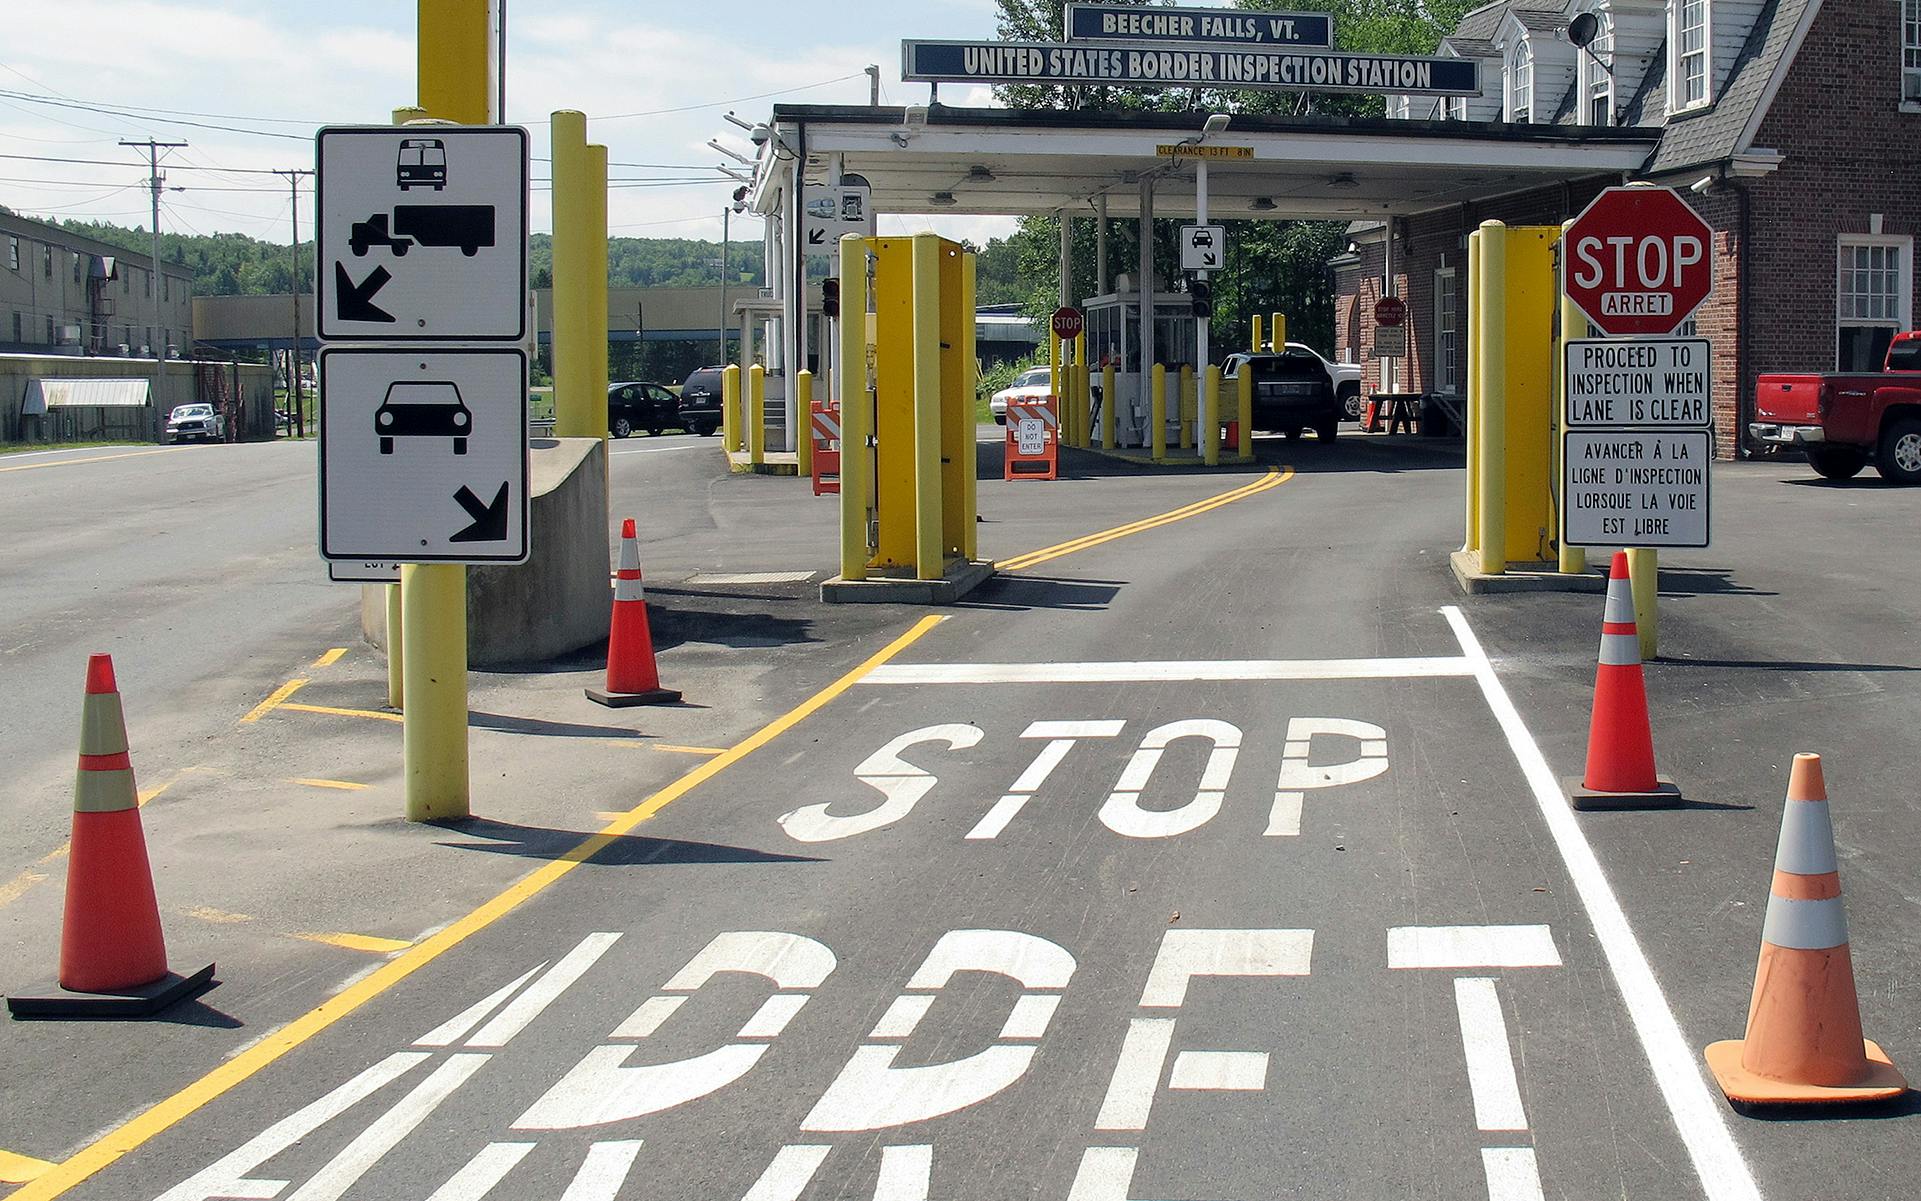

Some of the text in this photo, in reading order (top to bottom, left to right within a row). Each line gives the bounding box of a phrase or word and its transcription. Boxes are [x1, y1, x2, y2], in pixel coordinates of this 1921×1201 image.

[1102, 13, 1300, 42] BEECHER FALLS, VT.
[963, 47, 1431, 88] UNITED STATES BORDER INSPECTION STATION
[1159, 145, 1204, 156] CLEARANCE
[1210, 146, 1218, 156] 13
[1220, 147, 1229, 156] FT
[1574, 235, 1703, 289] STOP
[1606, 294, 1668, 314] ARRET
[1054, 317, 1081, 329] STOP
[1584, 345, 1691, 368] PROCEED TO
[1572, 372, 1703, 395] INSPECTION WHEN
[1573, 399, 1703, 421] LANE IS CLEAR
[1584, 442, 1643, 460] AVANCER
[1672, 443, 1689, 460] LA
[1572, 468, 1702, 485] LIGNE D'INSPECTION
[1576, 492, 1696, 510] LORSQUE LA VOIE
[1603, 517, 1669, 535] EST LIBRE
[776, 717, 1389, 843] STOP
[152, 924, 1564, 1201] ARRET
